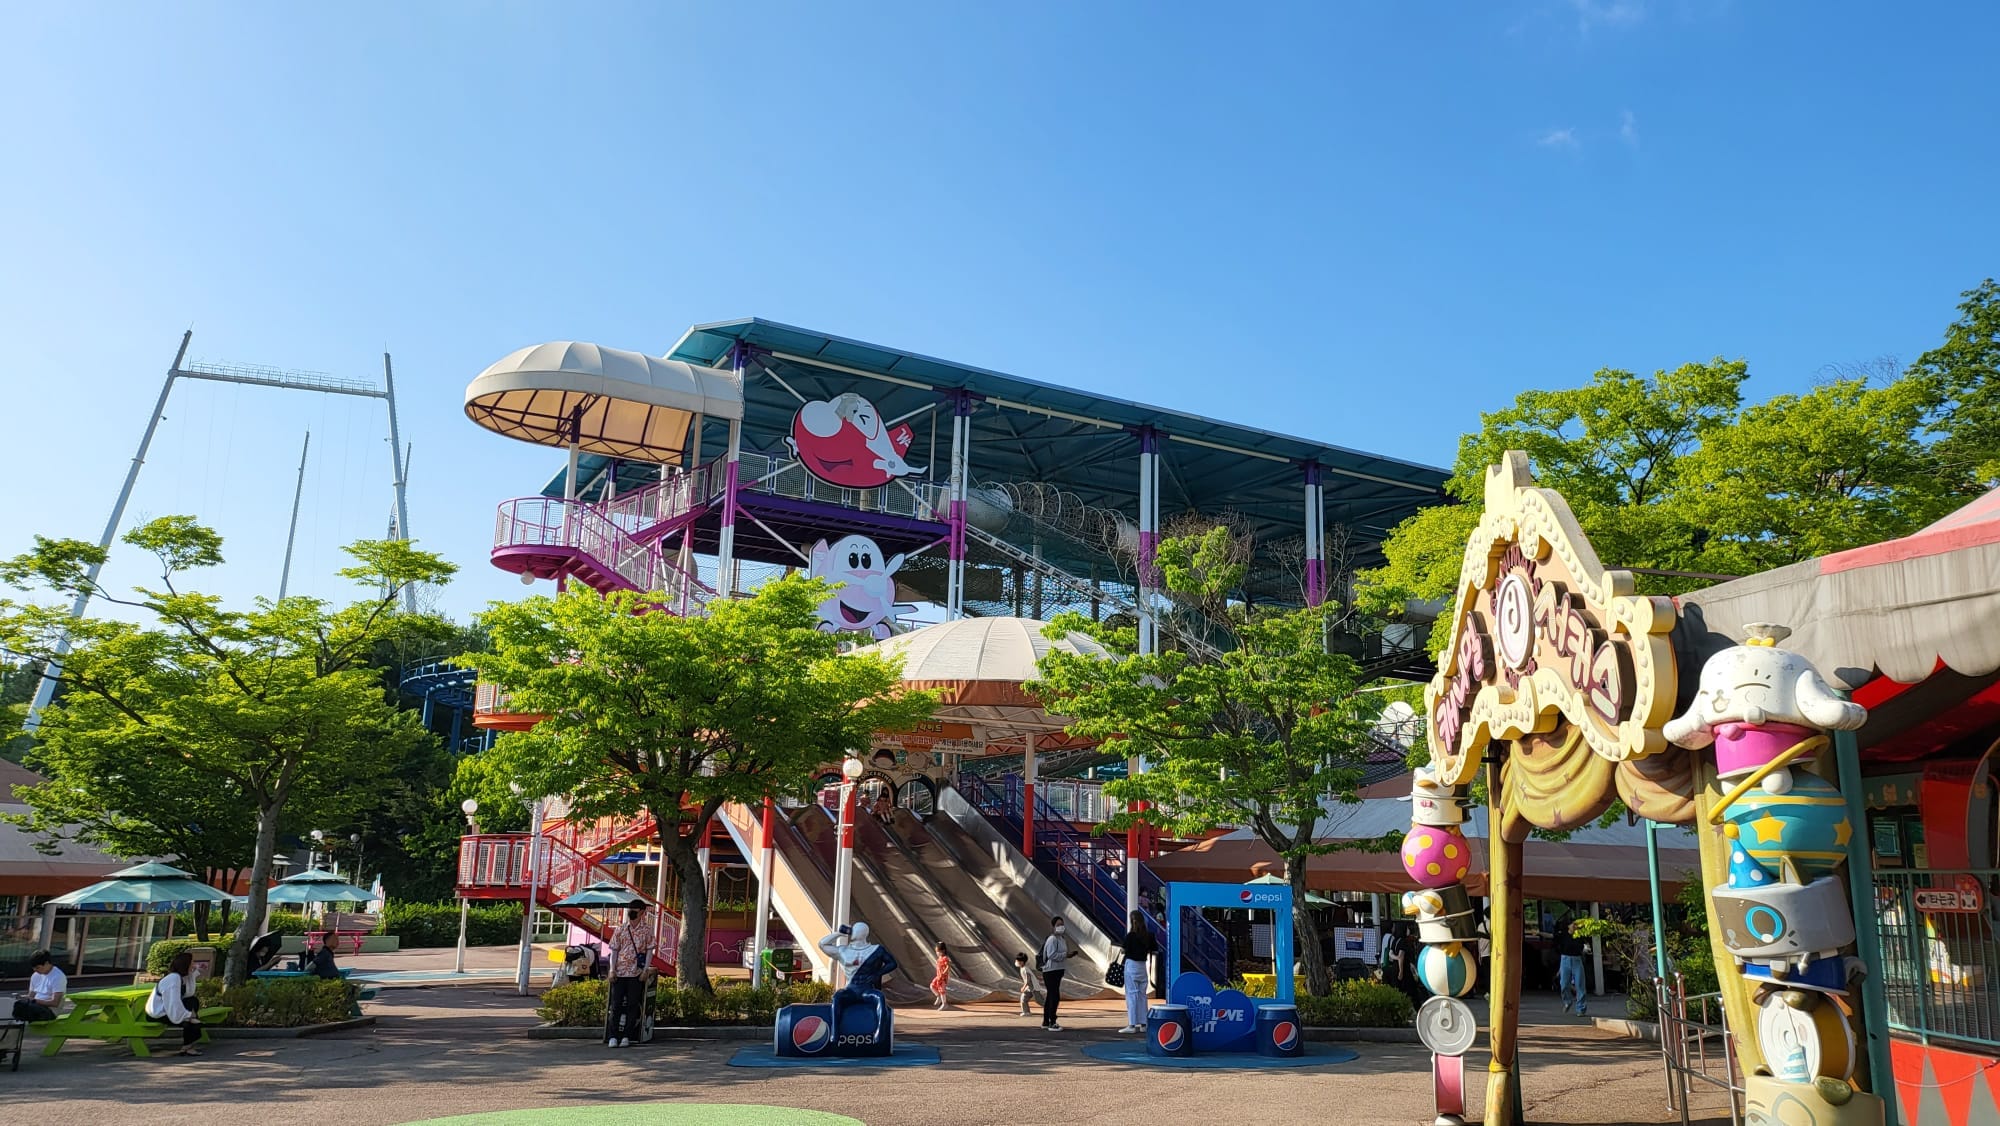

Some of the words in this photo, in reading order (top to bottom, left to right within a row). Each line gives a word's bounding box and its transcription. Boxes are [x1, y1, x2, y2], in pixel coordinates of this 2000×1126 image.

[1533, 581, 1622, 726] 서커스
[1254, 893, 1282, 903] pepsi
[1186, 995, 1212, 1008] FOR
[1211, 1008, 1244, 1022] LOVE
[1204, 1020, 1217, 1033] IT
